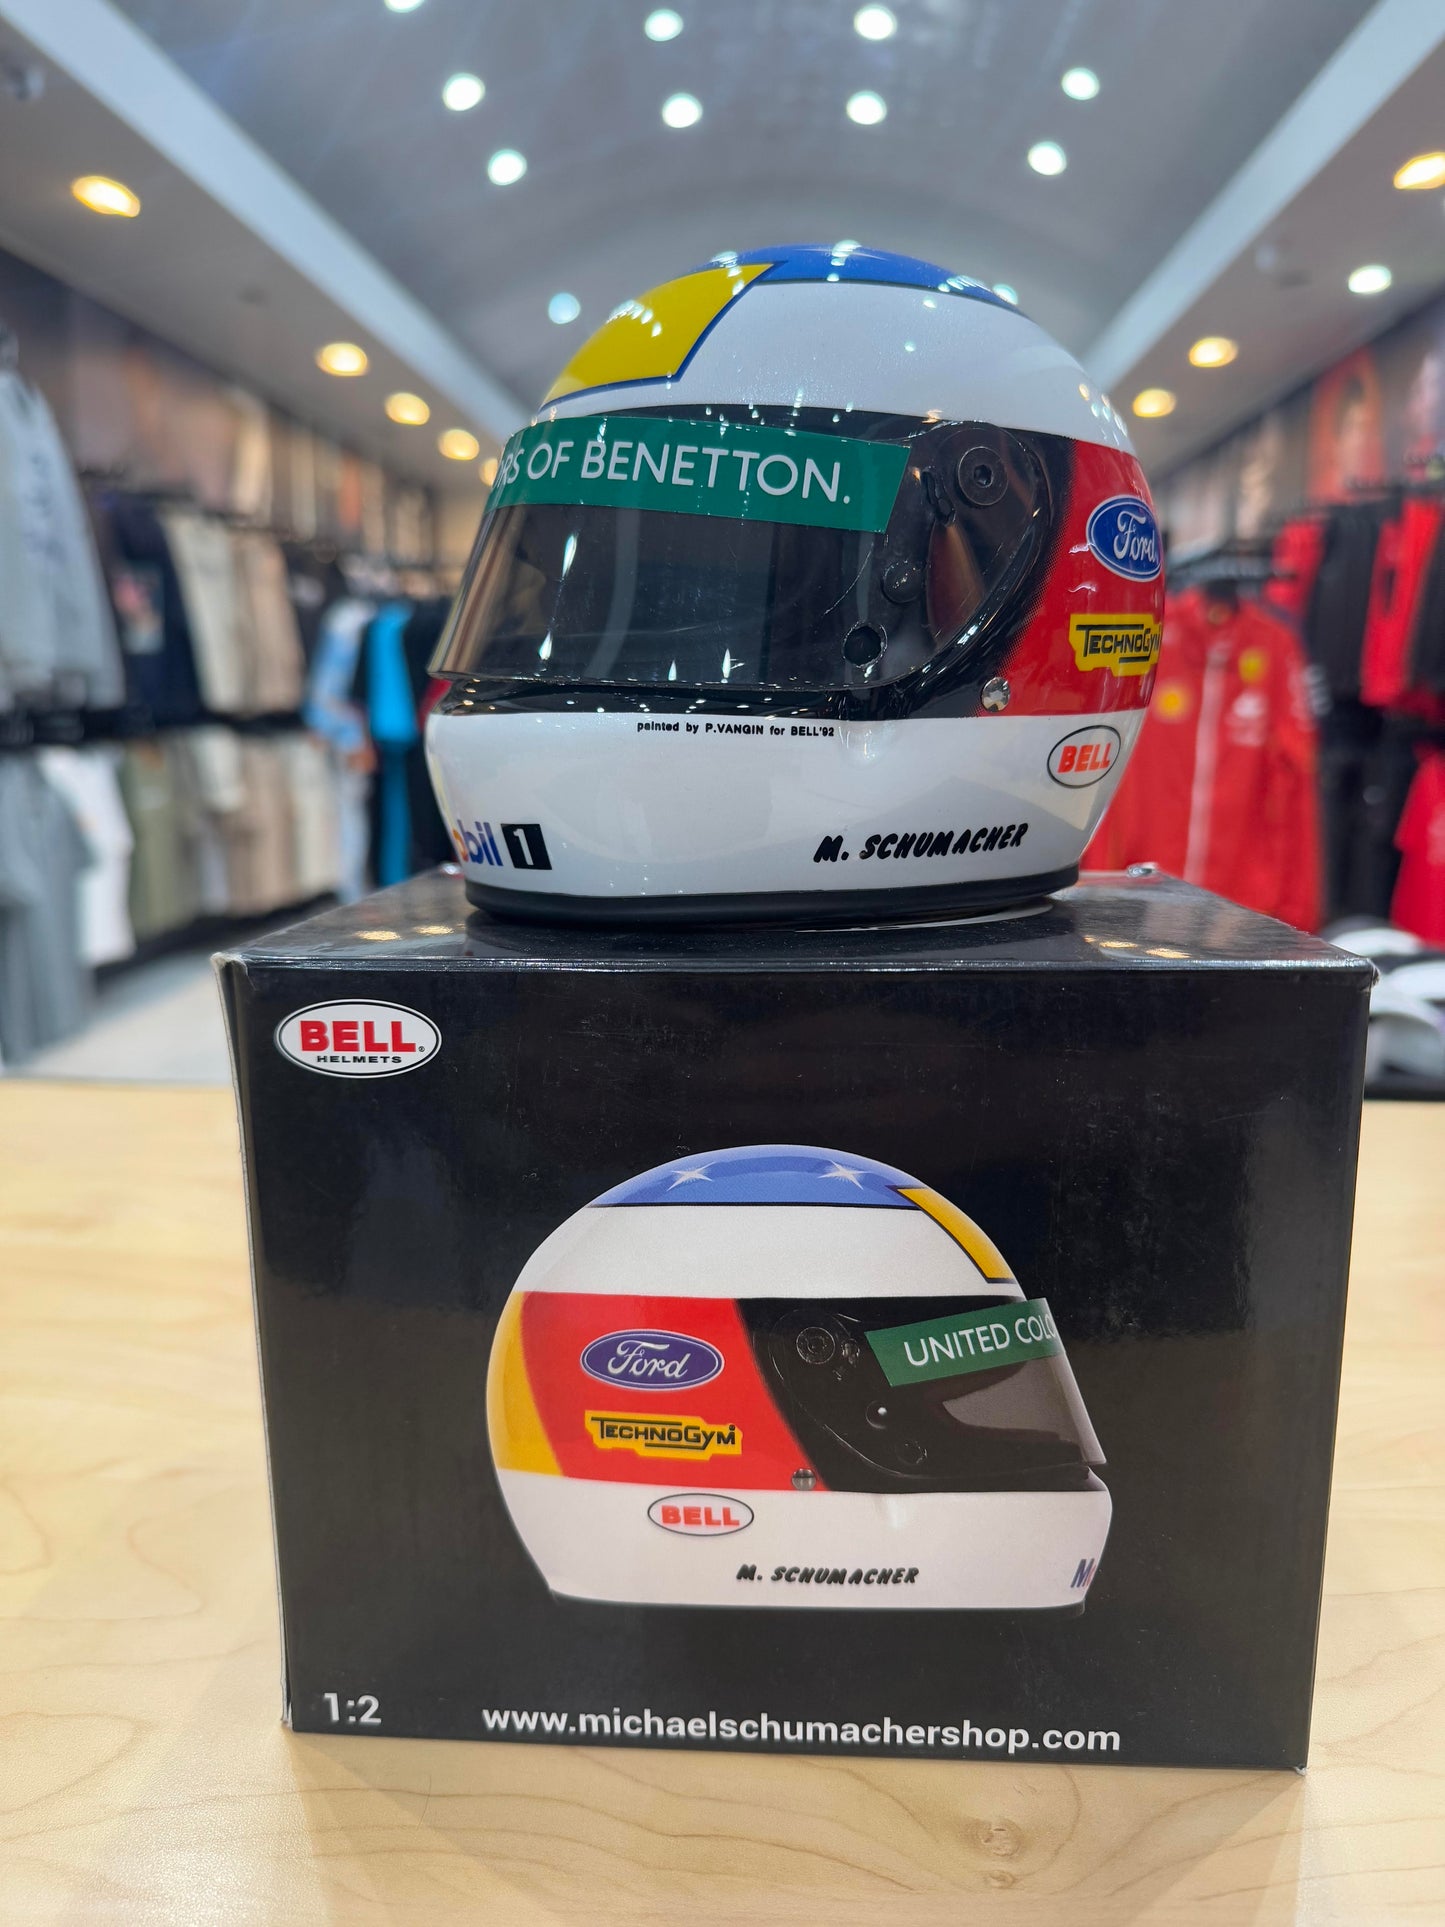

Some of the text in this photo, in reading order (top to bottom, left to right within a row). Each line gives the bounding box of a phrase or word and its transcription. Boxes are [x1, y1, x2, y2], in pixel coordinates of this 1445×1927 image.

[527, 441, 575, 480] OF
[581, 441, 850, 504] BENETTON.
[1112, 511, 1156, 563] Ford
[637, 721, 834, 737] painted by P.VANGIN for BELL'92
[1058, 742, 1111, 774] BELL
[513, 828, 535, 866] 1
[813, 823, 1029, 863] M. SCHUMACHER
[300, 1020, 417, 1053] BELL
[316, 1055, 402, 1064] HELMETS
[607, 1339, 691, 1378] Ford
[904, 1323, 1011, 1367] UNITED
[591, 1416, 736, 1451] TECHNOGYM
[661, 1505, 740, 1526] BELL
[736, 1564, 919, 1585] M. SCHUMACHER
[323, 1692, 382, 1725] 1:2
[482, 1707, 1120, 1755] www.michaelschumachershop.com
